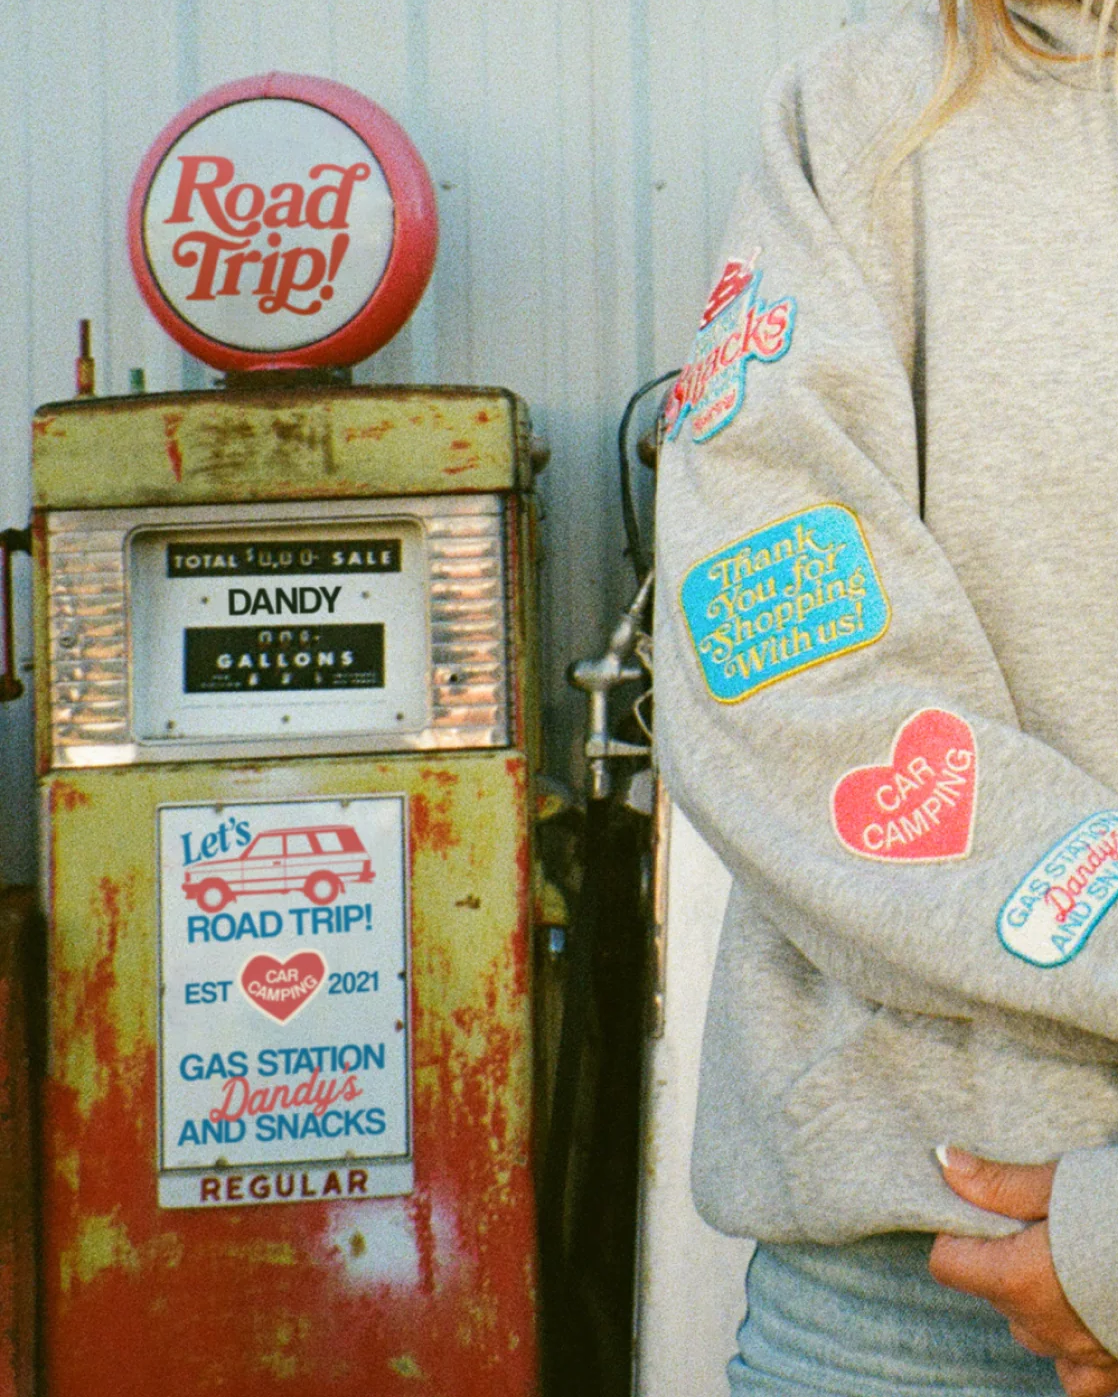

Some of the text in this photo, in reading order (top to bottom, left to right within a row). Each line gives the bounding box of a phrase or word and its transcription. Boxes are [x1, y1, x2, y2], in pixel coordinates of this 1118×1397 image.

[162, 155, 372, 238] Road
[171, 229, 351, 316] Trip!
[174, 554, 239, 569] TOTAL
[332, 551, 392, 566] SALE
[705, 543, 846, 619] You for
[707, 523, 833, 589] Thank
[227, 585, 343, 616] DANDY
[700, 565, 866, 664] Shopping
[215, 650, 355, 670] GALLONS
[724, 601, 865, 679] With us!
[861, 747, 973, 850] CAMPING
[876, 756, 936, 812] CAR
[180, 816, 253, 867] Let's
[187, 903, 375, 944] ROAD TRIP!
[1006, 878, 1052, 929] GAS
[1050, 901, 1093, 954] AND
[184, 970, 380, 1004] EST 2021
[247, 975, 320, 1003] CAMPING
[264, 967, 300, 984] CAR
[179, 1042, 386, 1082] GAS STATION
[208, 1061, 364, 1124] Dandy's
[176, 1107, 387, 1147] AND SNACKS
[201, 1167, 370, 1203] REGULAR
